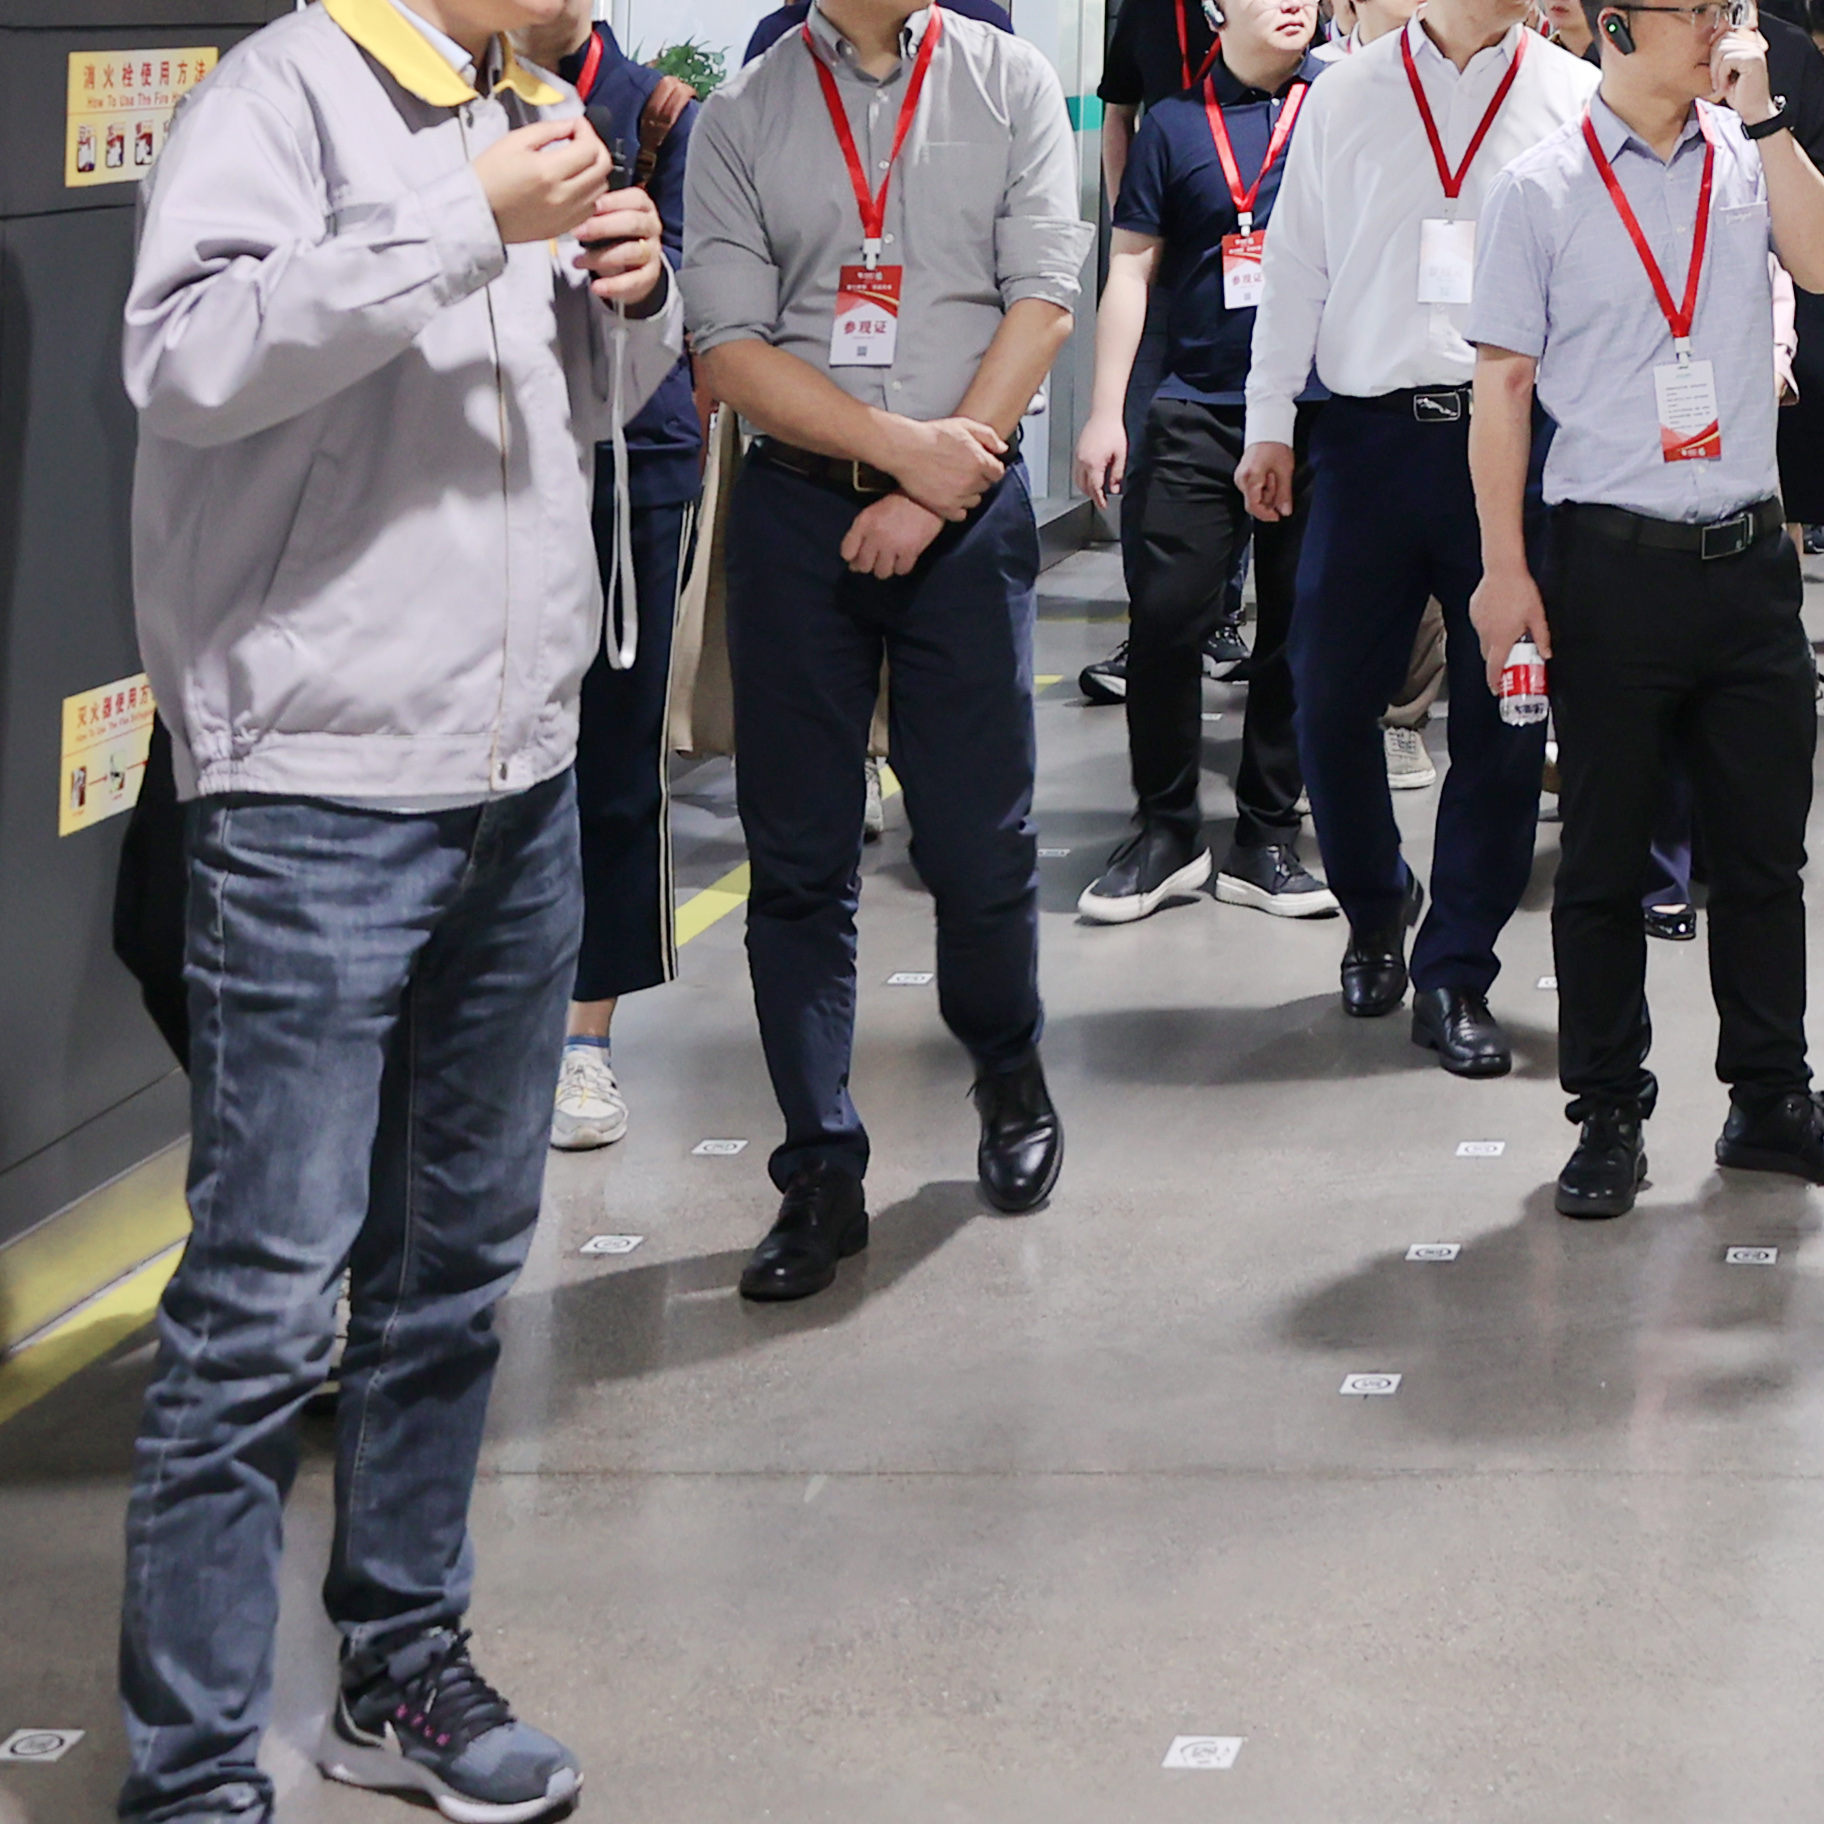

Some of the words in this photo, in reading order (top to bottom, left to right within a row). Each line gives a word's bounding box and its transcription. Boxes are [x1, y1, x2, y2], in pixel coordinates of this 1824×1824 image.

[84, 59, 206, 90] 消火栓使用方法
[87, 97, 104, 109] How
[107, 94, 117, 107] To
[137, 92, 152, 106] The
[154, 91, 169, 105] Fire
[844, 320, 888, 335] 参观证
